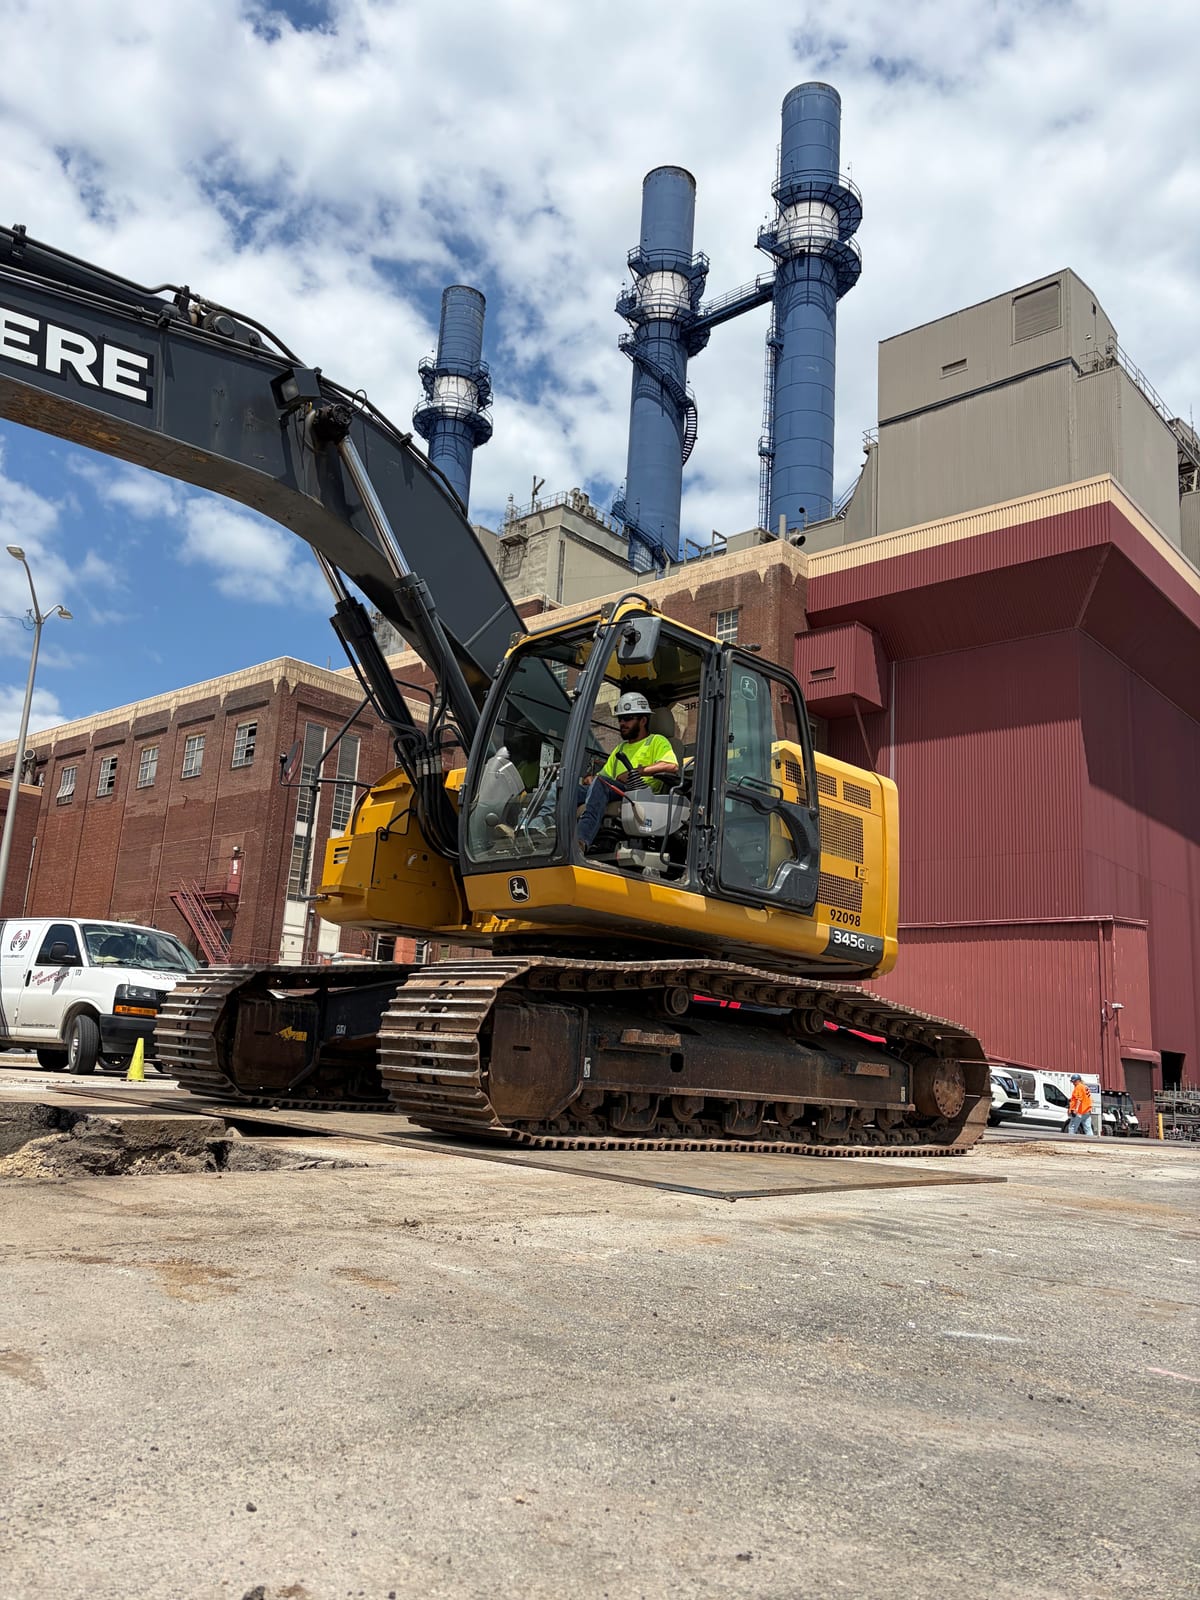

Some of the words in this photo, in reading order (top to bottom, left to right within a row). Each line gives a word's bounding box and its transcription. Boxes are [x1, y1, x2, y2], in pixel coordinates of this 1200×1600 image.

[0, 307, 148, 402] ERE
[830, 909, 861, 927] 92098
[833, 931, 865, 949] 345G
[866, 944, 875, 952] LC
